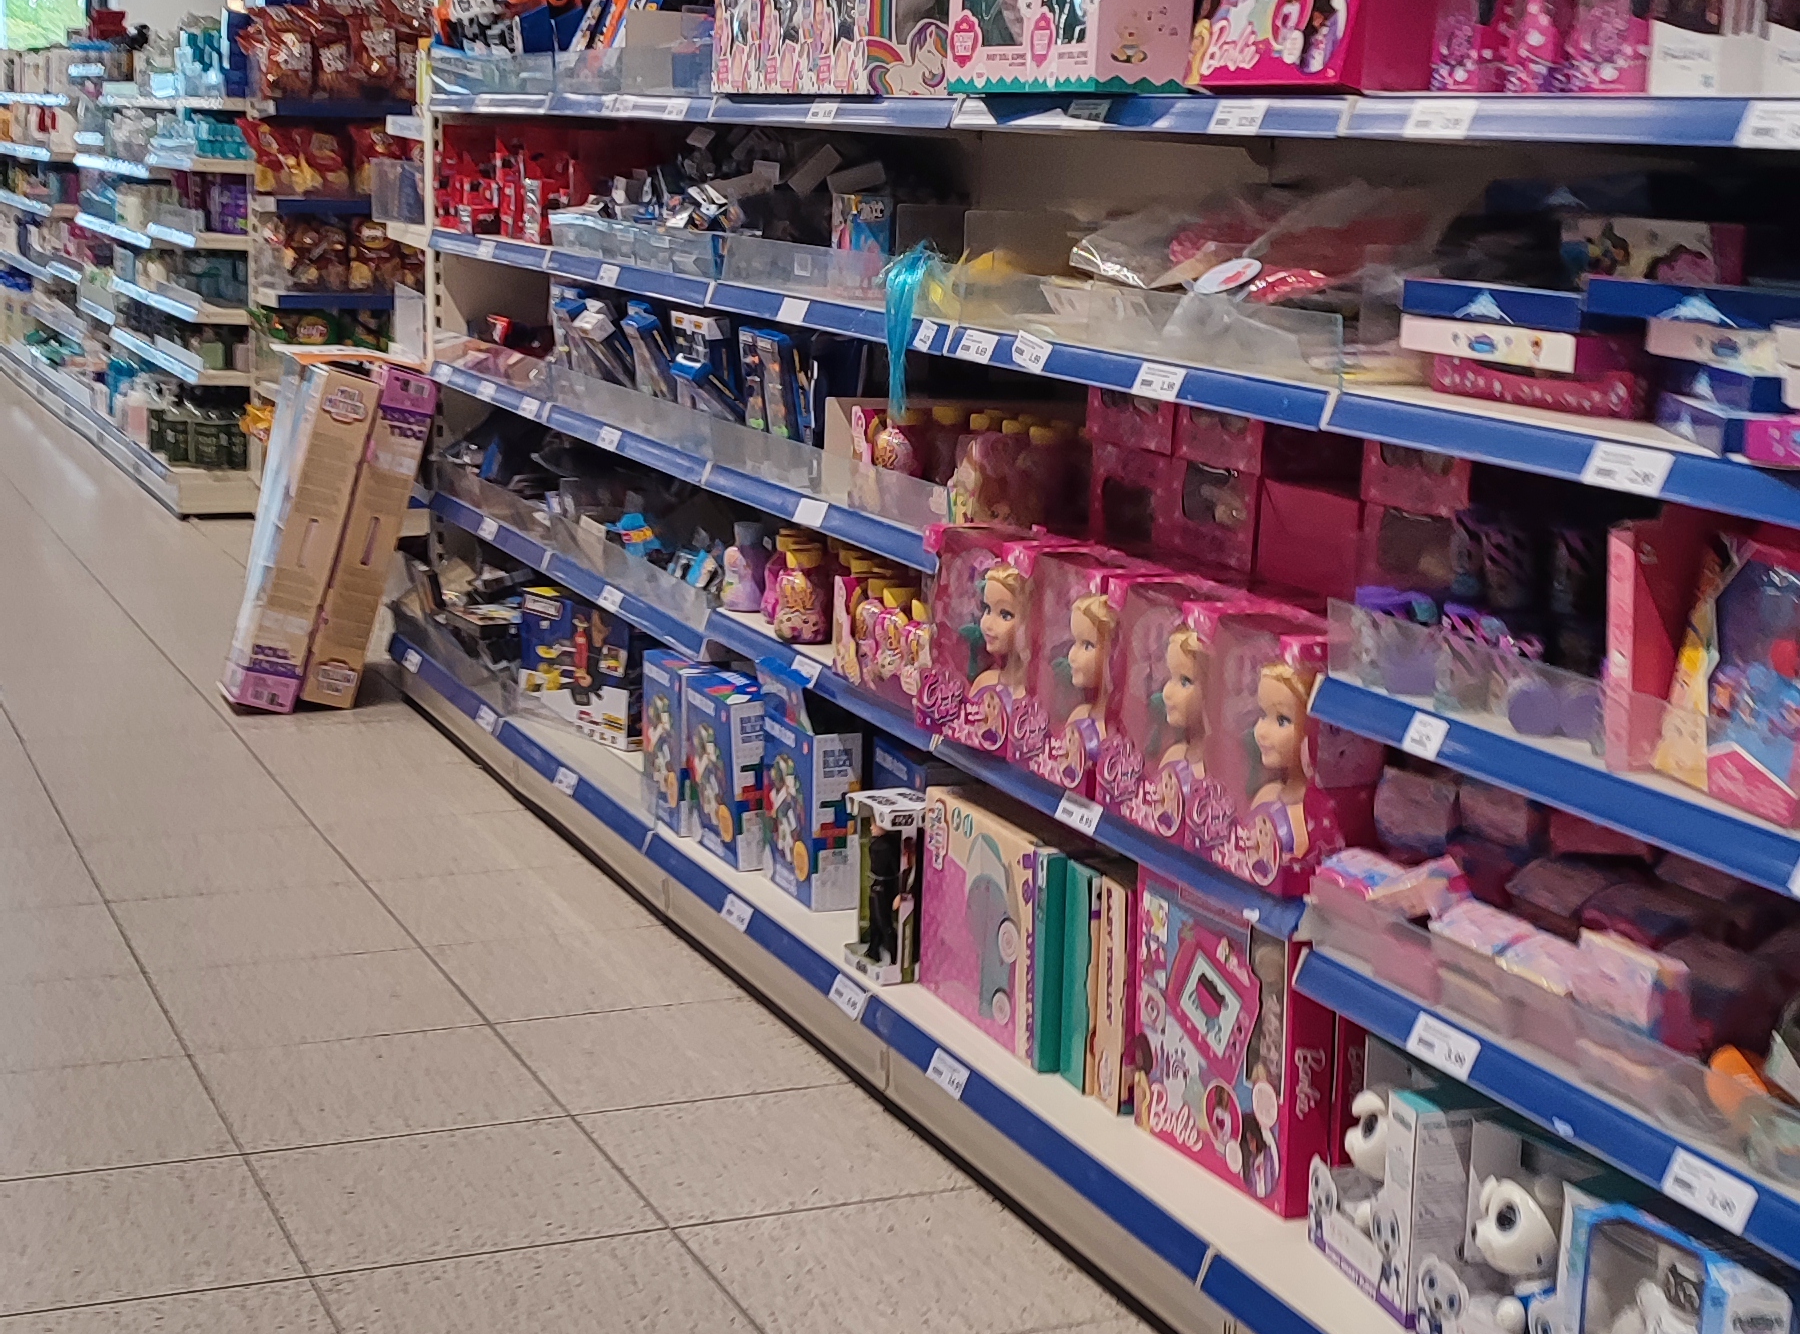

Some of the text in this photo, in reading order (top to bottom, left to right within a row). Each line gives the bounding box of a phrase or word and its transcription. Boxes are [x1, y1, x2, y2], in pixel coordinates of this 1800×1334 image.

[1200, 20, 1260, 76] Barbie
[1150, 1081, 1203, 1153] Barbie
[1294, 1046, 1326, 1121] Barbie
